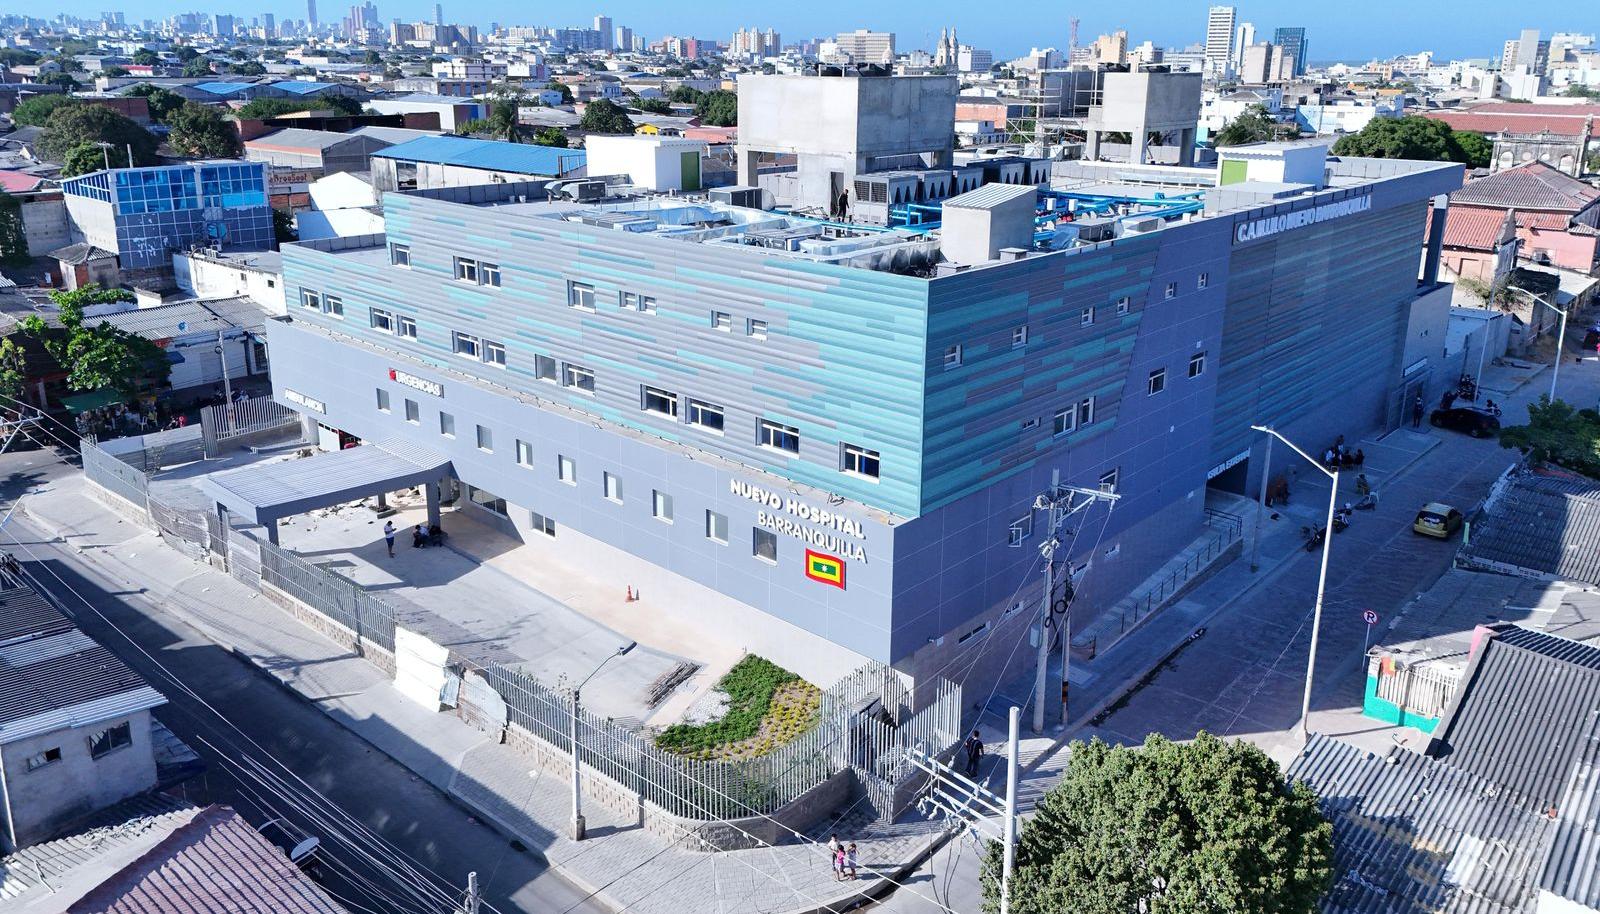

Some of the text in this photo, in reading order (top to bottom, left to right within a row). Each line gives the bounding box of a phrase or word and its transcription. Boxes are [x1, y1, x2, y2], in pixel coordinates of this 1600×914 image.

[395, 370, 442, 397] URGENCIAS
[730, 479, 866, 540] NUEVO HOSPITAL
[758, 510, 867, 563] BARRANQUILLA
